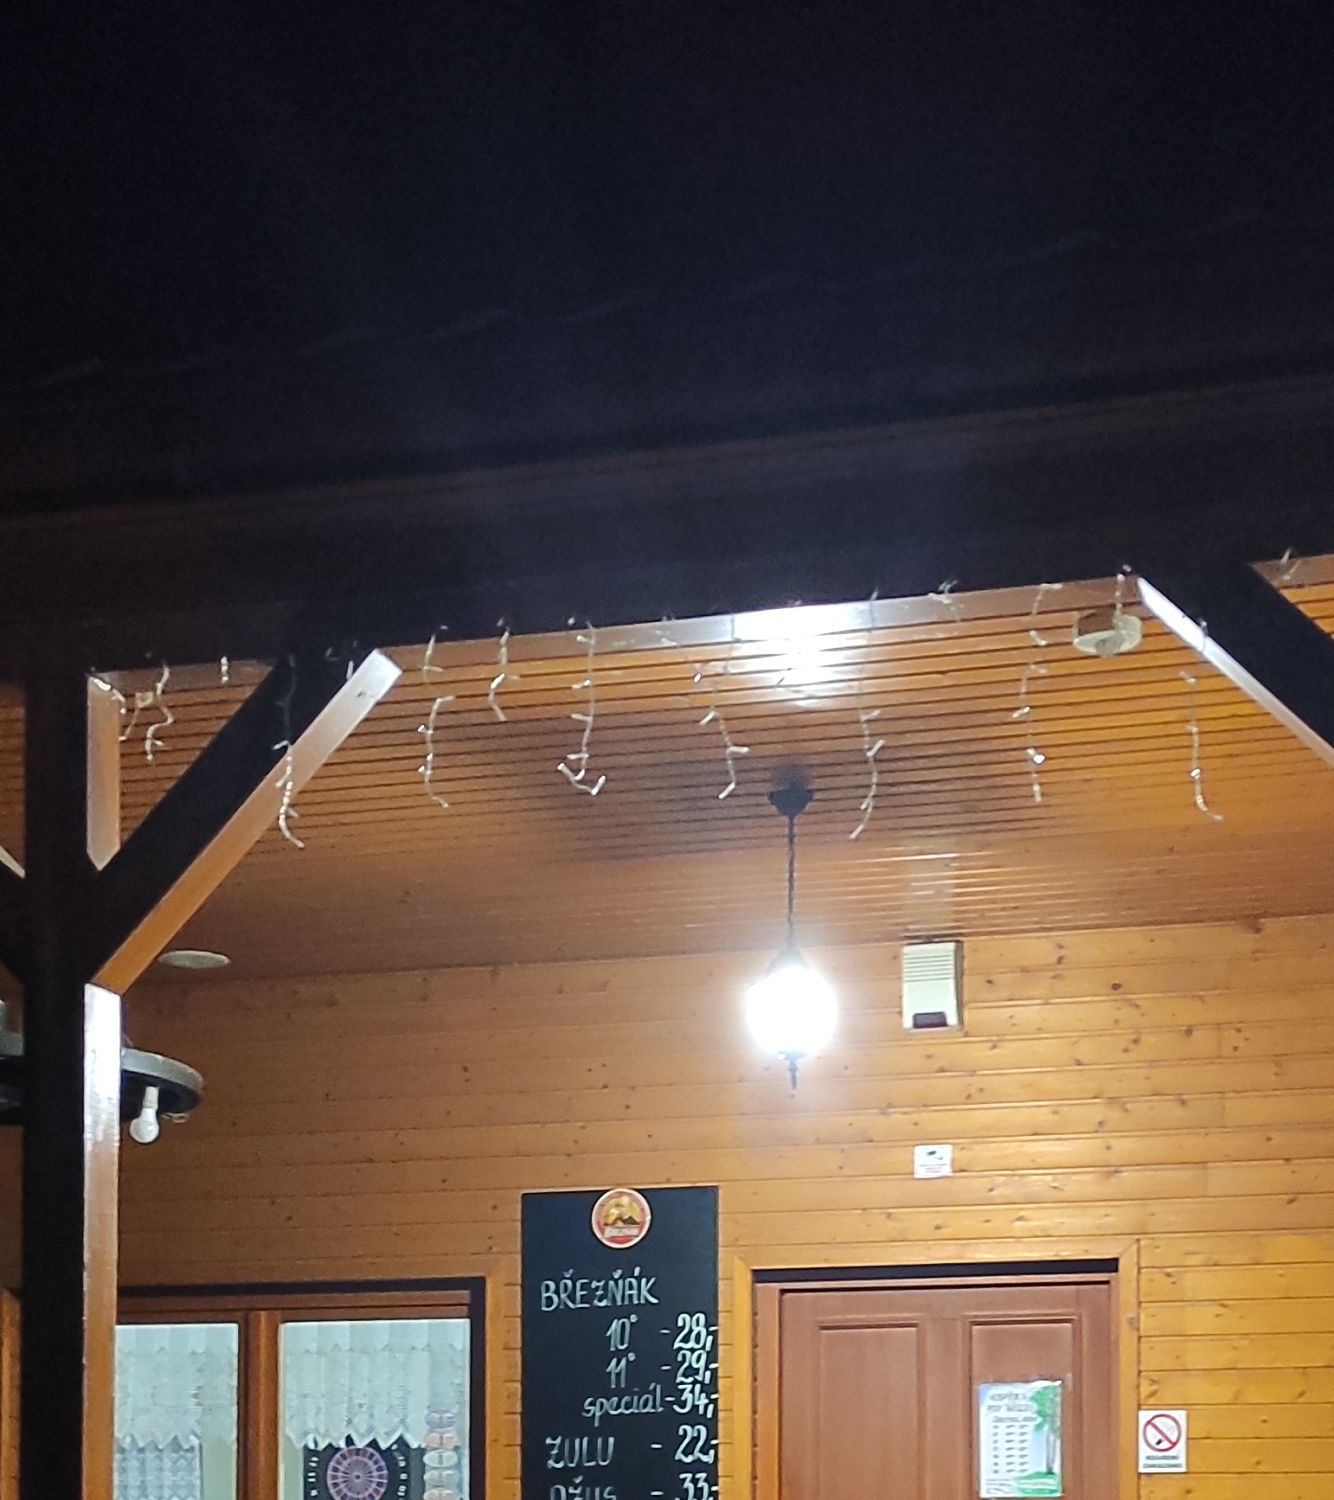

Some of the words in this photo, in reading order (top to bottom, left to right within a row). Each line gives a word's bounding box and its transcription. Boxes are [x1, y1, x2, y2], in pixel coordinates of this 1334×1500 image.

[540, 1266, 660, 1312] BŘEZŇÁK
[605, 1314, 638, 1351] 10°
[581, 1382, 665, 1428] speciál
[545, 1435, 615, 1469] ZULU
